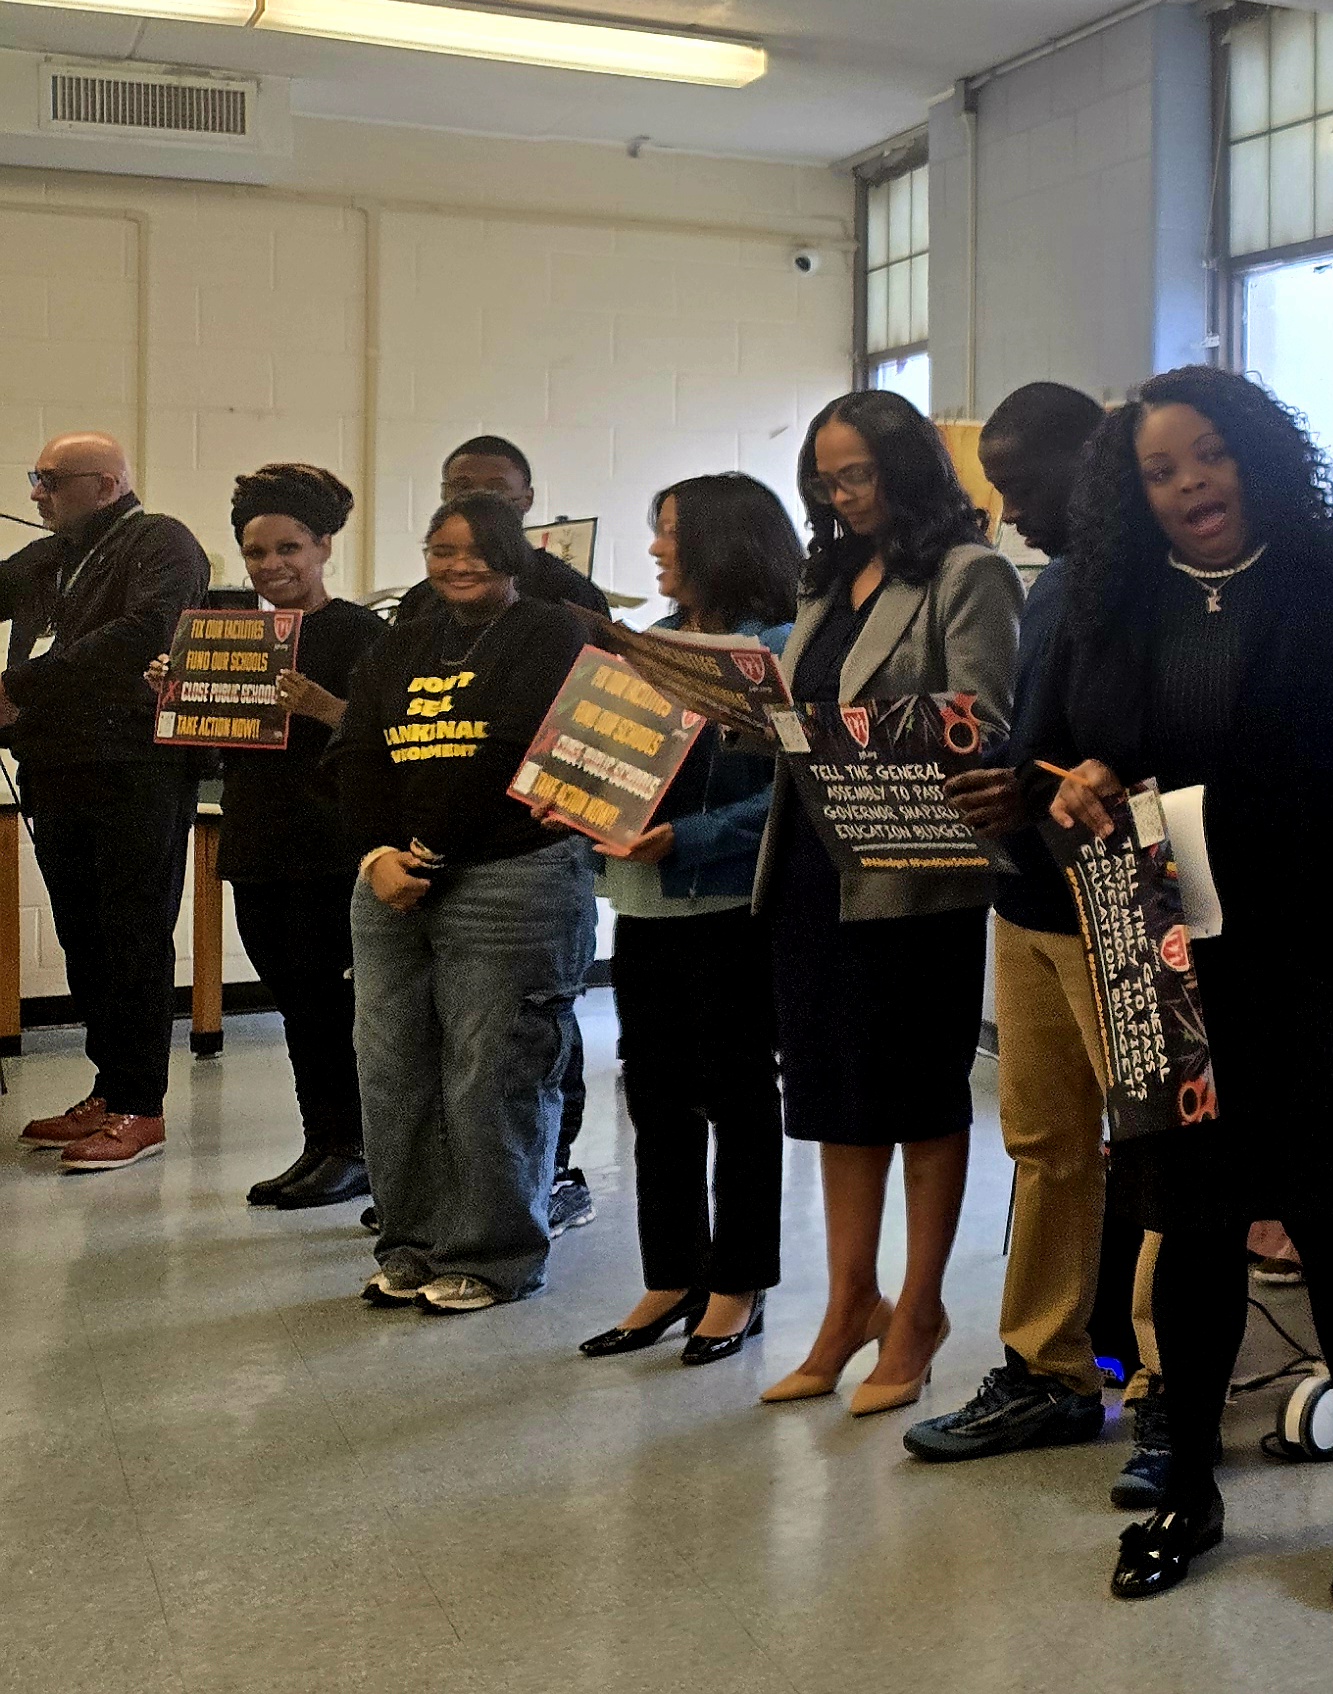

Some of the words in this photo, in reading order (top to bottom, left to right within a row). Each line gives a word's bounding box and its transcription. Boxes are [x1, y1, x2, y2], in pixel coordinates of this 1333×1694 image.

[240, 684, 278, 704] SCHOOL
[810, 764, 844, 781] TELL
[845, 764, 873, 781] THE
[876, 762, 946, 781] GENERAL
[827, 784, 885, 801] ASSEMBLY
[890, 785, 910, 801] TO
[913, 784, 944, 801] PASS
[823, 803, 899, 821] GOVERNOR
[899, 804, 960, 821] SHAPIRO
[834, 824, 912, 840] EDUCATION
[913, 824, 975, 841] BUDGET
[1095, 836, 1126, 970] GOVERNOR
[1121, 979, 1148, 1100] SHAPIRO'S
[1113, 854, 1139, 966] ASSEMBLY
[1133, 977, 1145, 1010] TO
[1139, 1020, 1156, 1073] PASS
[1121, 836, 1139, 898] TELL
[1133, 905, 1149, 951] THE
[1143, 962, 1171, 1083] GENERAL
[1081, 844, 1118, 980] EDUCATION
[1111, 988, 1137, 1099] BUDGET!
